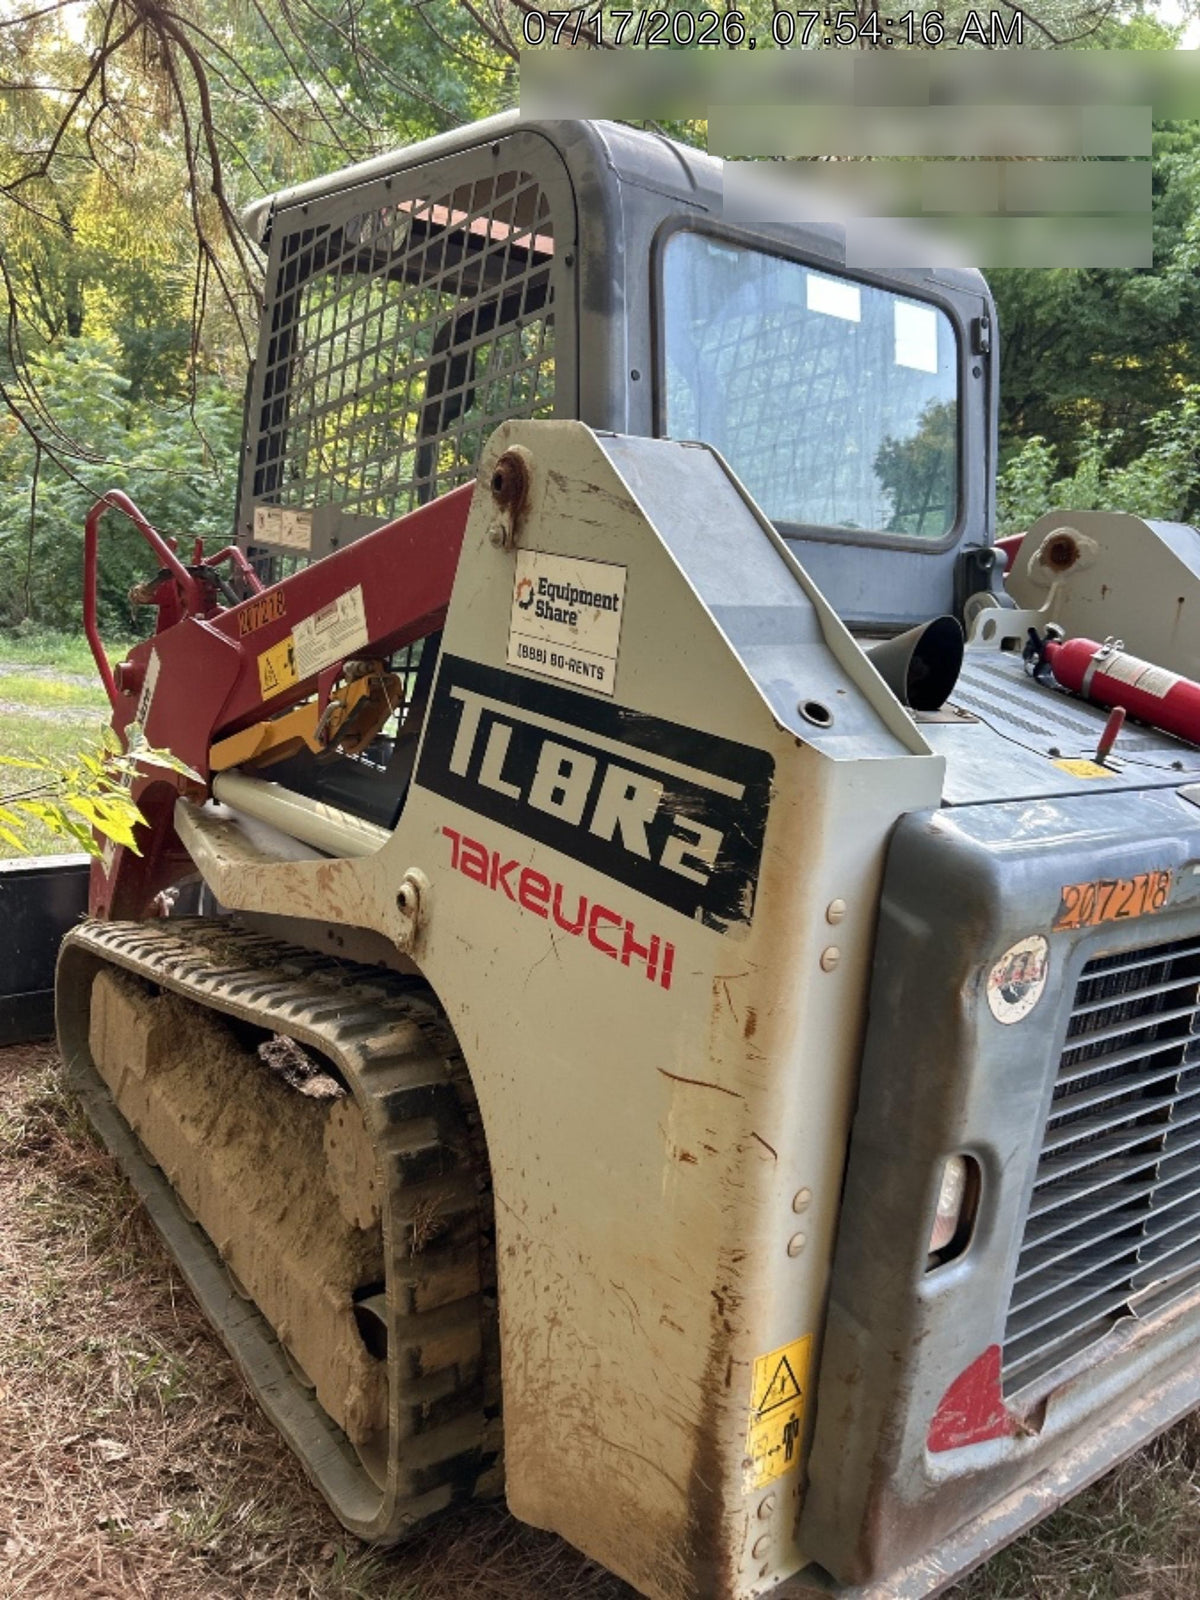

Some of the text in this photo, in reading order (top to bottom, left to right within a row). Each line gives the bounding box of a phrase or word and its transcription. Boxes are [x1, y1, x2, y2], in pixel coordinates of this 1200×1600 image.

[535, 598, 578, 626] Share
[537, 577, 619, 612] Equipment
[550, 653, 605, 680] 80-RENTS
[449, 685, 745, 886] TL8R2
[1056, 870, 1169, 928] 207218
